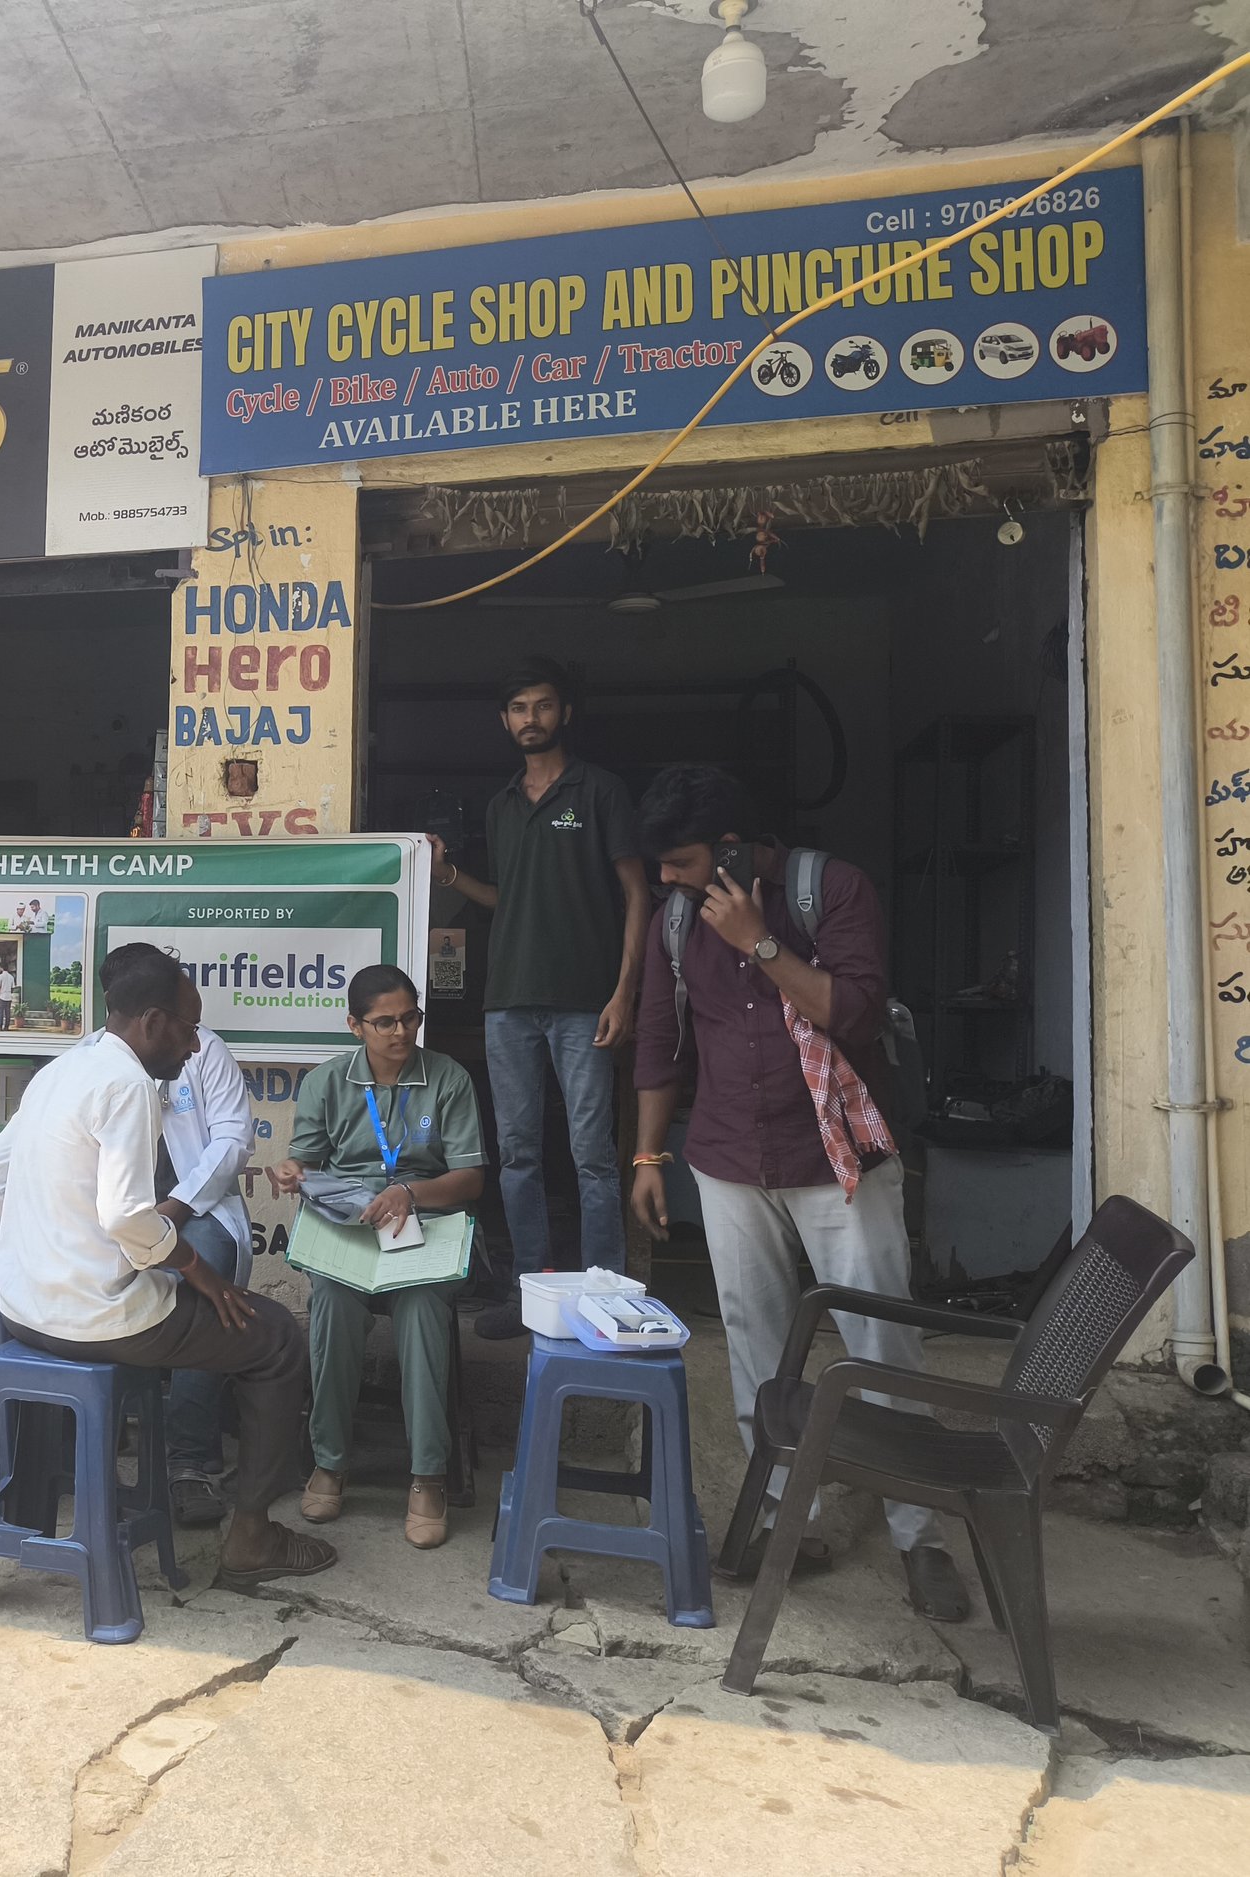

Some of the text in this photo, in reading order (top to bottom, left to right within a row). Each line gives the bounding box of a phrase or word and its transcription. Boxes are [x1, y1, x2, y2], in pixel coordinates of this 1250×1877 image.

[866, 208, 915, 233] Cell
[227, 219, 1105, 374] CITY CYCLE SHOP AND PUNCTURE SHOP
[74, 314, 196, 338] MANIKANTA
[63, 337, 203, 363] AUTOMOBILES
[226, 382, 300, 424] Cycle
[329, 373, 397, 407] Bike
[425, 364, 499, 396] Auto
[531, 353, 586, 383] Car
[618, 339, 742, 374] Tractor
[92, 404, 172, 427] మణికంఠ
[318, 389, 637, 449] AVAILABLE HERE
[113, 505, 187, 519] 9885754733
[185, 580, 352, 635] HONDA
[183, 644, 331, 693] Hero
[175, 705, 311, 747] BAJAJ
[108, 854, 193, 876] CAMP
[187, 908, 295, 919] SUPPORTED BY
[233, 991, 346, 1008] Foundation
